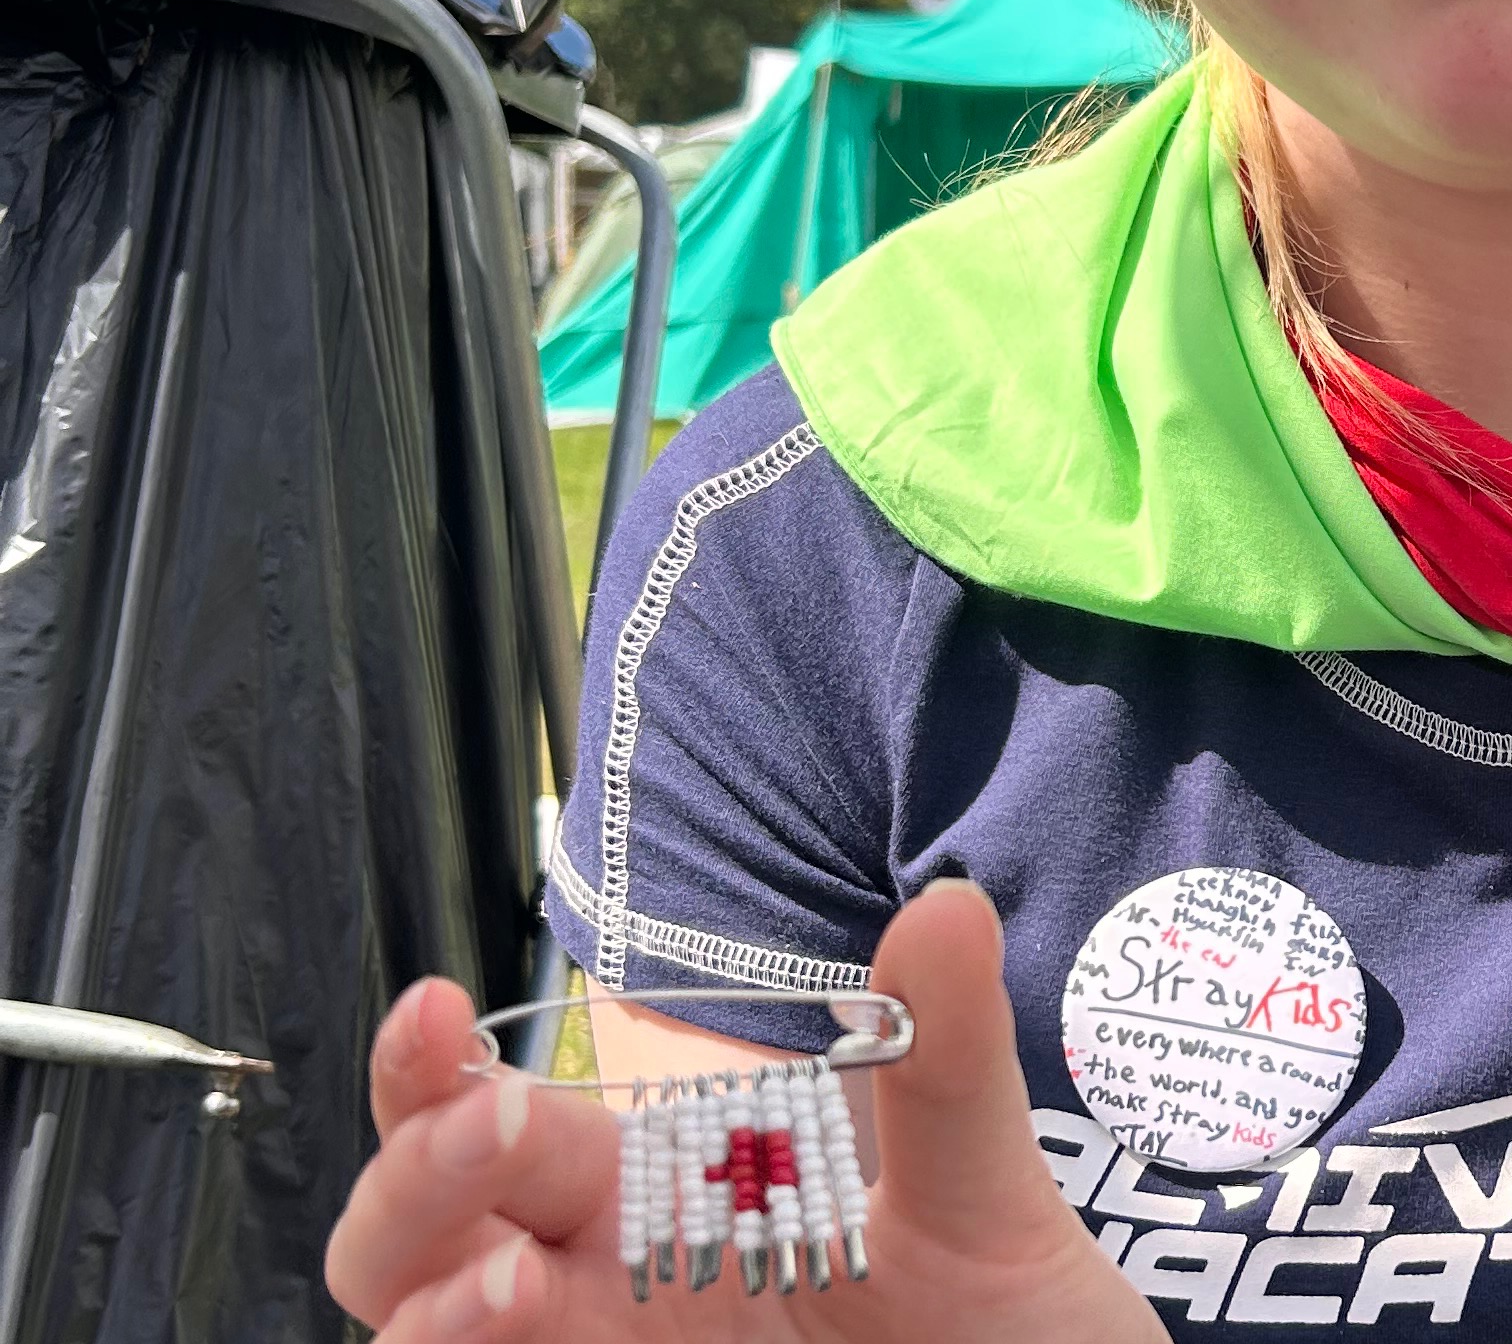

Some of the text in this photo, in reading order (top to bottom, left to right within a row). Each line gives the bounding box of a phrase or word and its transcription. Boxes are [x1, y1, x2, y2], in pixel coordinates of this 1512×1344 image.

[1102, 935, 1254, 1029] Stray
[1246, 976, 1352, 1033] Kids
[1084, 1053, 1136, 1084] the
[1235, 1090, 1277, 1120] and
[1086, 1085, 1148, 1113] make
